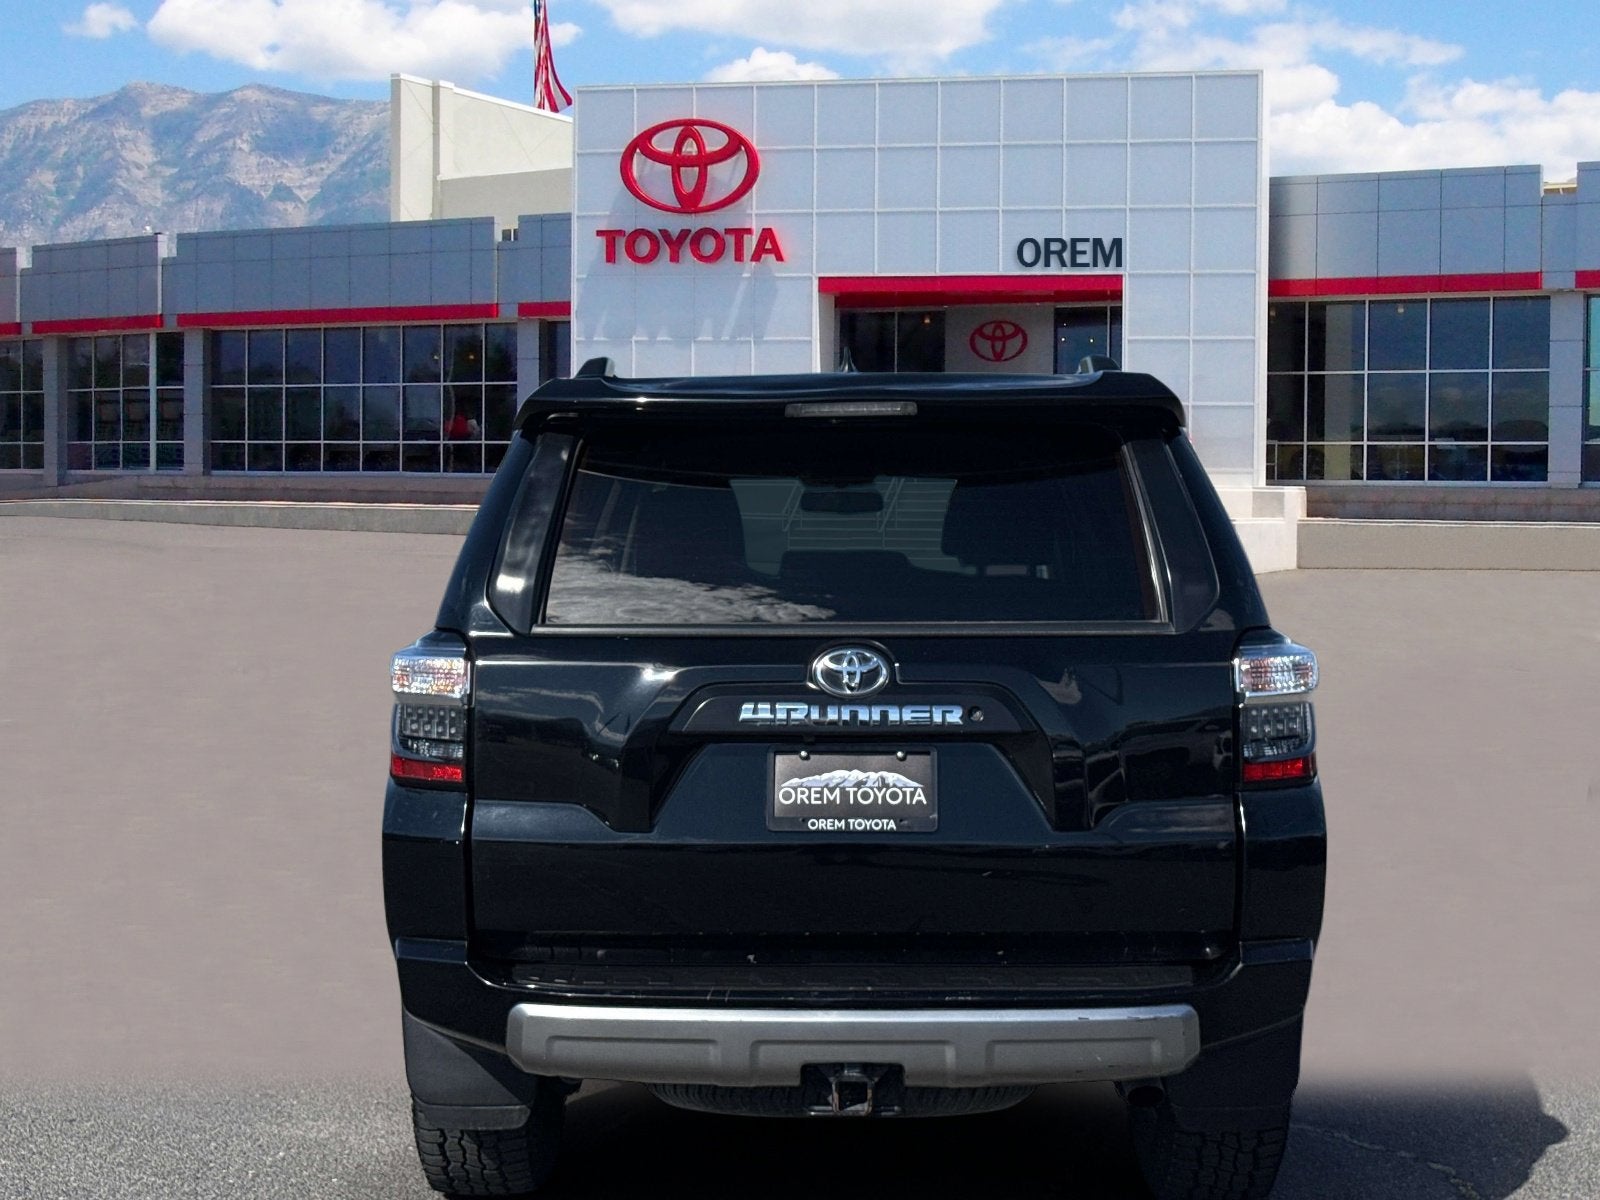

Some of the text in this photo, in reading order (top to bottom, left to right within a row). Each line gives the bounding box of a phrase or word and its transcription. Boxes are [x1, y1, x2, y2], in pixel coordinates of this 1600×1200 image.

[596, 227, 784, 264] TOYOTA
[1016, 237, 1123, 268] OREM
[778, 787, 928, 805] OREM TOYOTA
[807, 818, 897, 831] OREM TOYOTA
